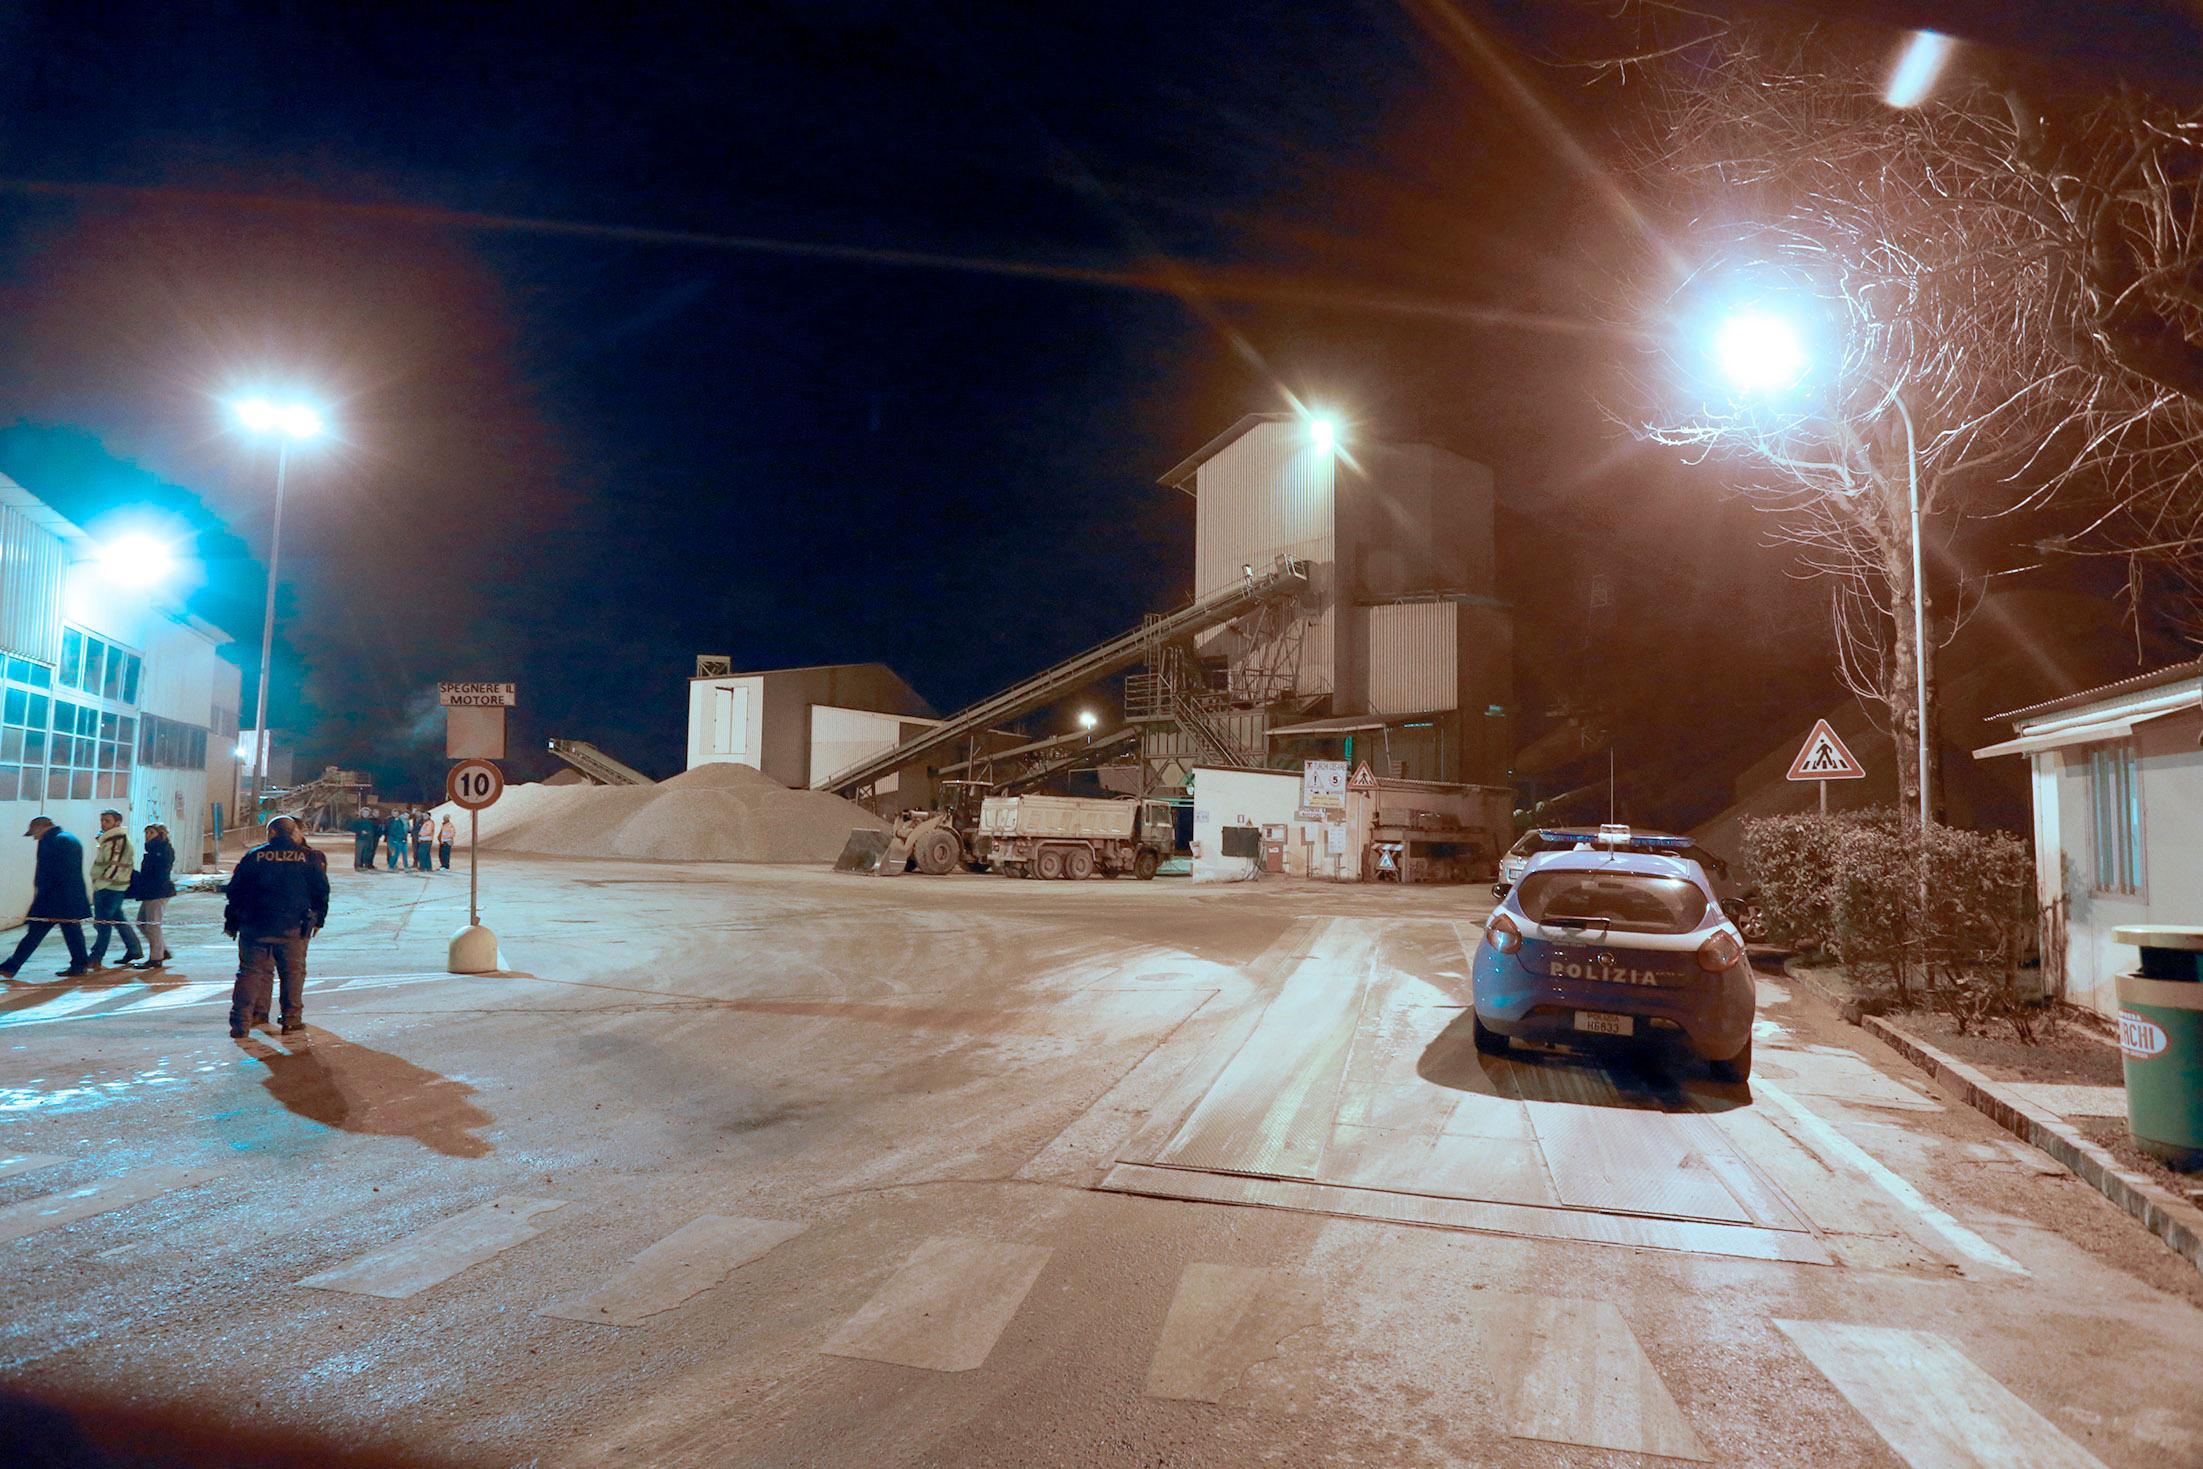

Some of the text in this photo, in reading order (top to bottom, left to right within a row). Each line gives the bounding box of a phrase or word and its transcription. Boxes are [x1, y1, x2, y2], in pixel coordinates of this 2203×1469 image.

[440, 684, 514, 693] SPEGNERE IL
[450, 695, 504, 705] MOTORE
[461, 773, 489, 796] 10
[1332, 776, 1338, 784] 5
[256, 851, 306, 862] POLIZIA
[1550, 961, 1657, 986] POLIZIA
